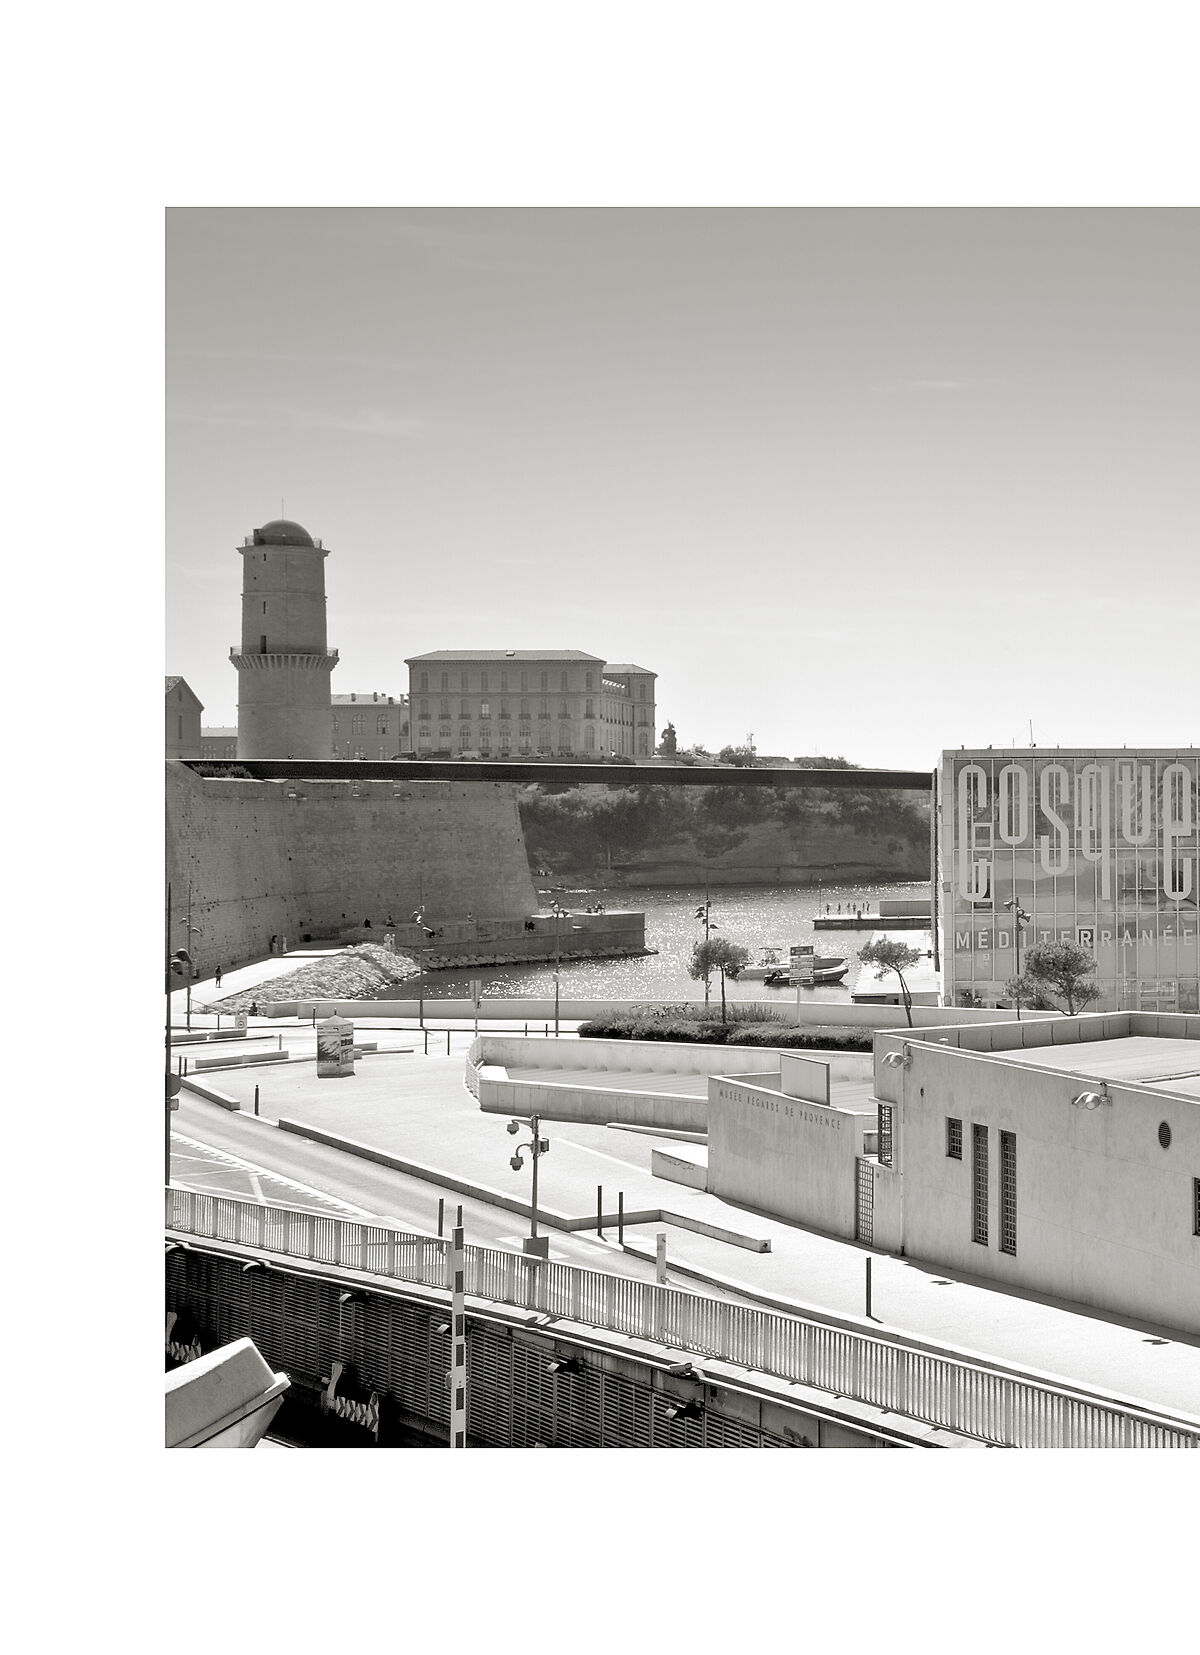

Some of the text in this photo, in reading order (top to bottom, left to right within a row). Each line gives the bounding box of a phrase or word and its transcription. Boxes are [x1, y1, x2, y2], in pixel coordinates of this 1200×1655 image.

[956, 926, 1194, 949] MÉDITERRANÉE
[719, 1089, 841, 1130] MUSÉE REGARDS DE PROVENCE
